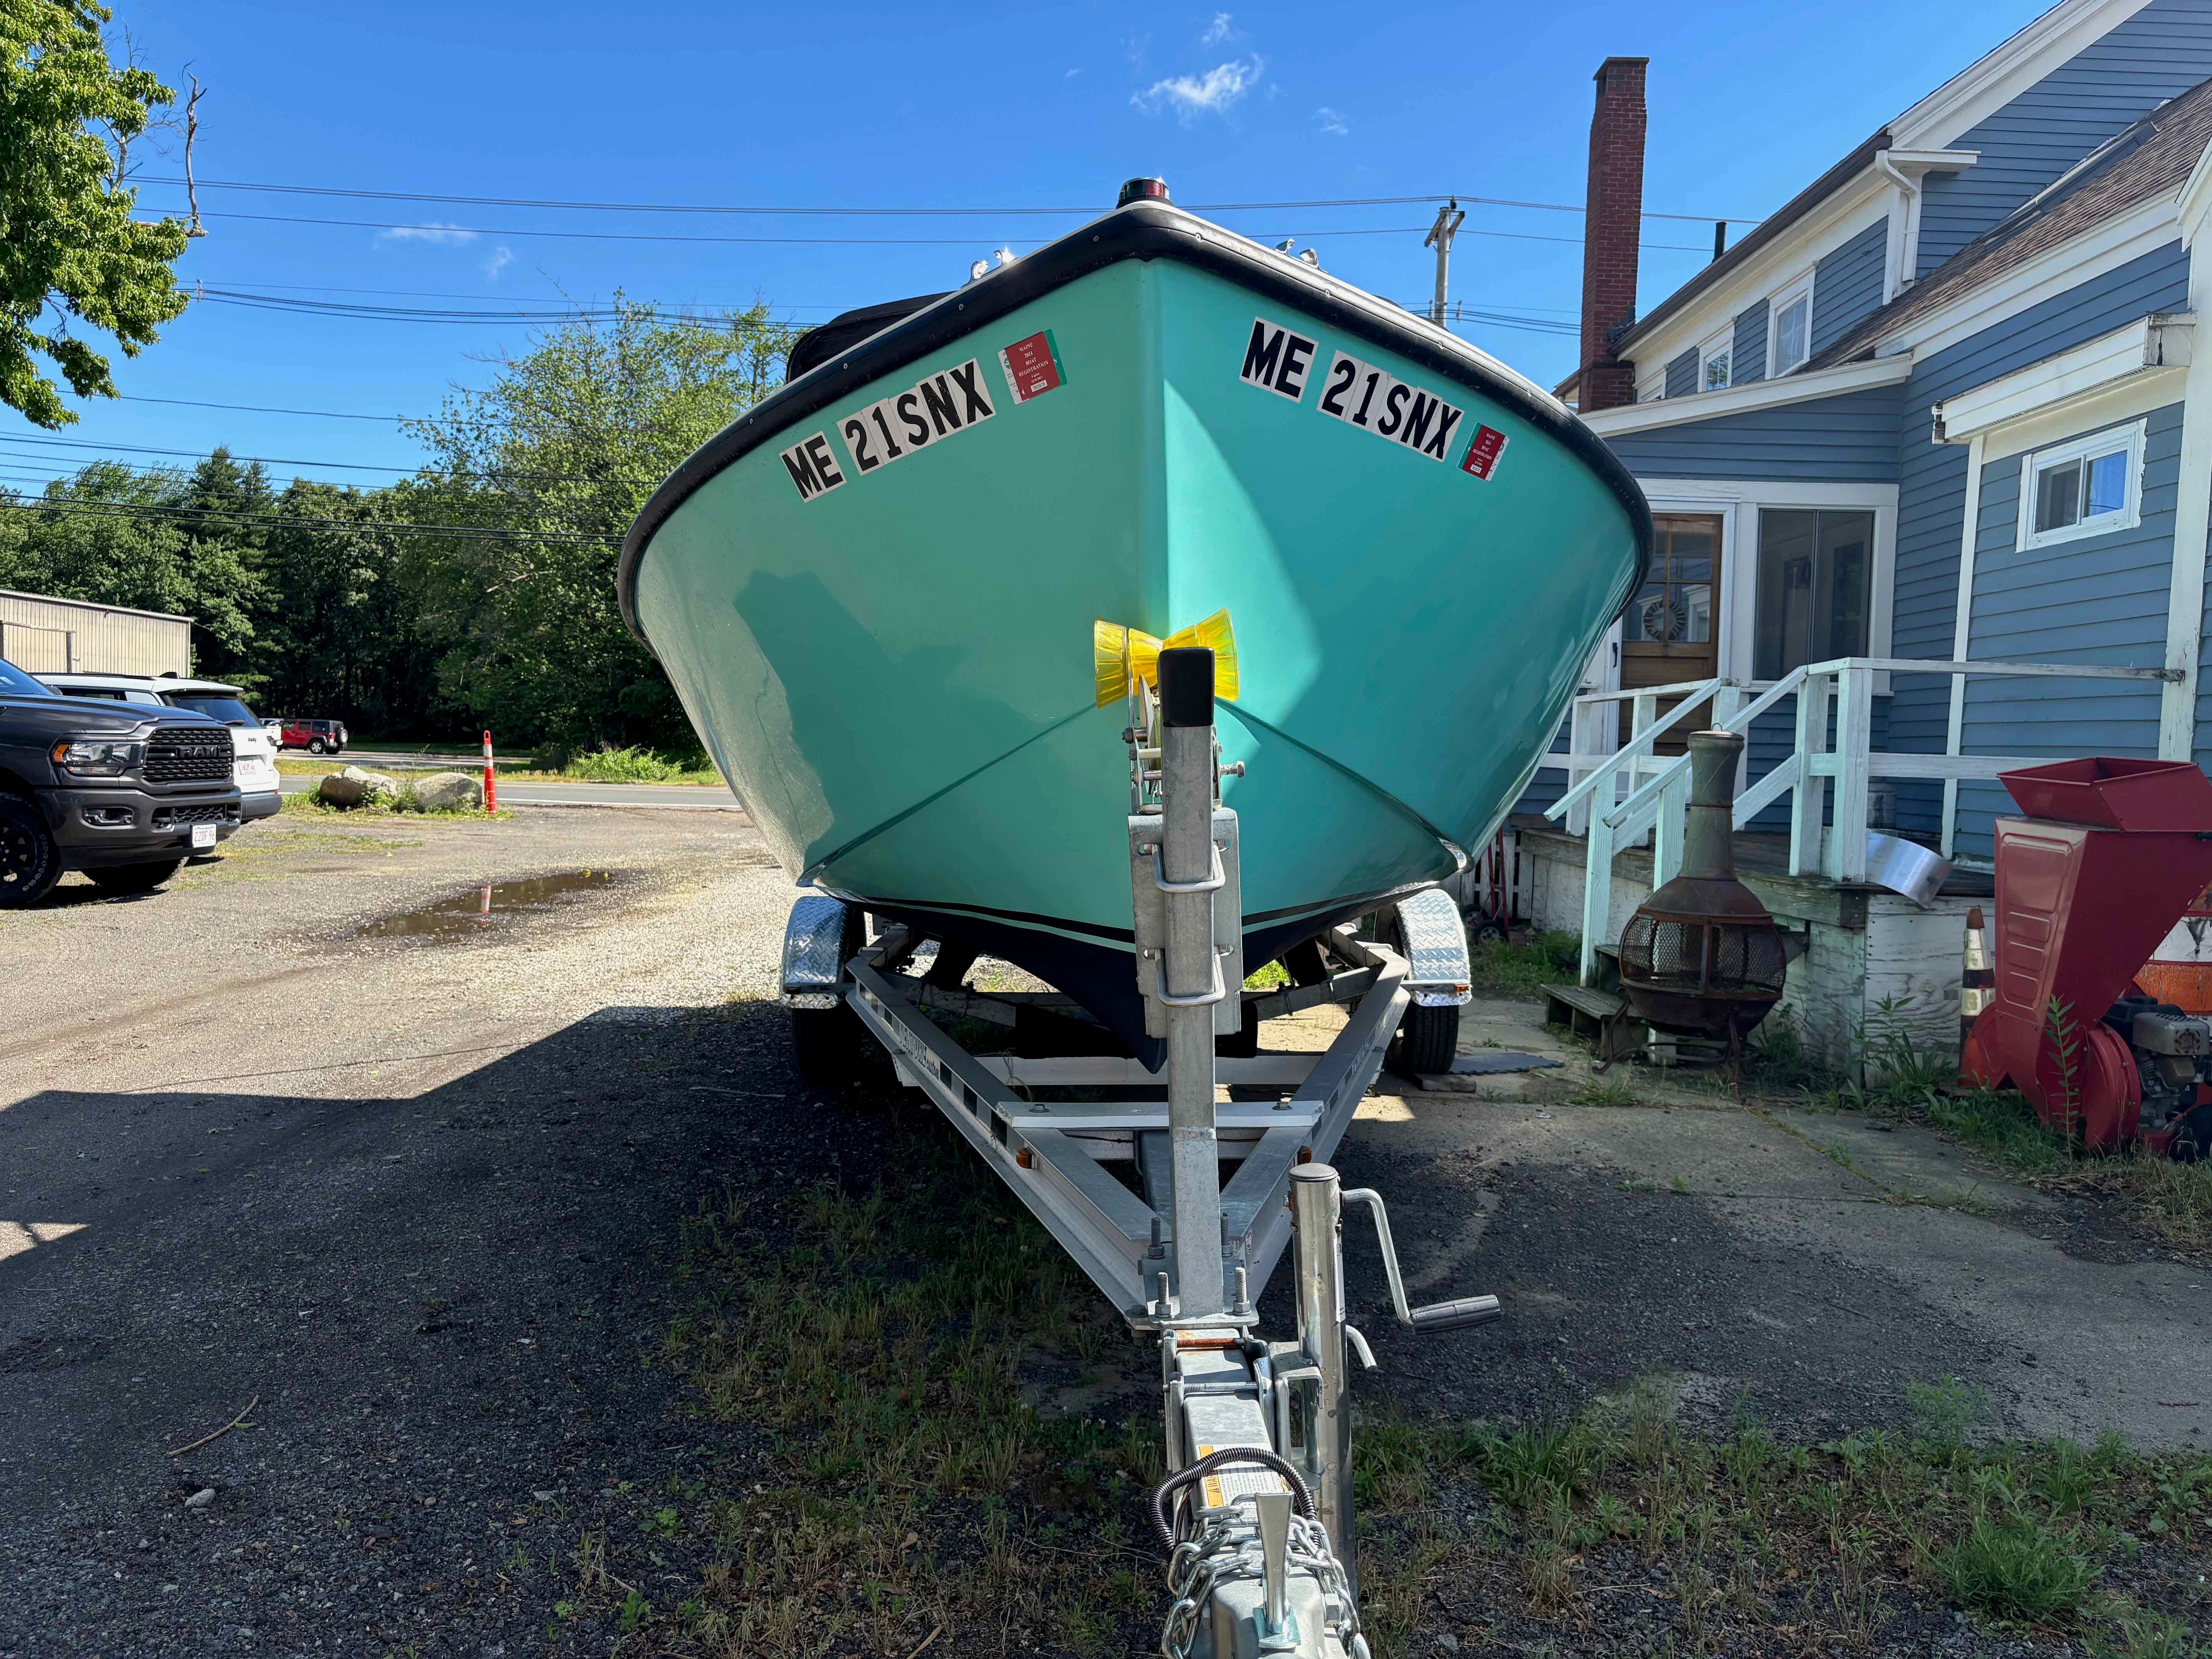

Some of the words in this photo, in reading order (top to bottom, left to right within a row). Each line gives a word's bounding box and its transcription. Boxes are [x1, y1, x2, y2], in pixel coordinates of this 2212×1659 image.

[1019, 342, 1034, 352] MAINE
[1025, 357, 1036, 366] BOAT
[1018, 360, 1049, 377] REGISTRATION
[1242, 323, 1315, 398] ME
[1322, 359, 1462, 460] 21SNX
[781, 434, 843, 499] ME
[845, 362, 993, 472] 21SNX
[1473, 448, 1492, 460] REGISTRATION
[179, 746, 218, 756] RAM
